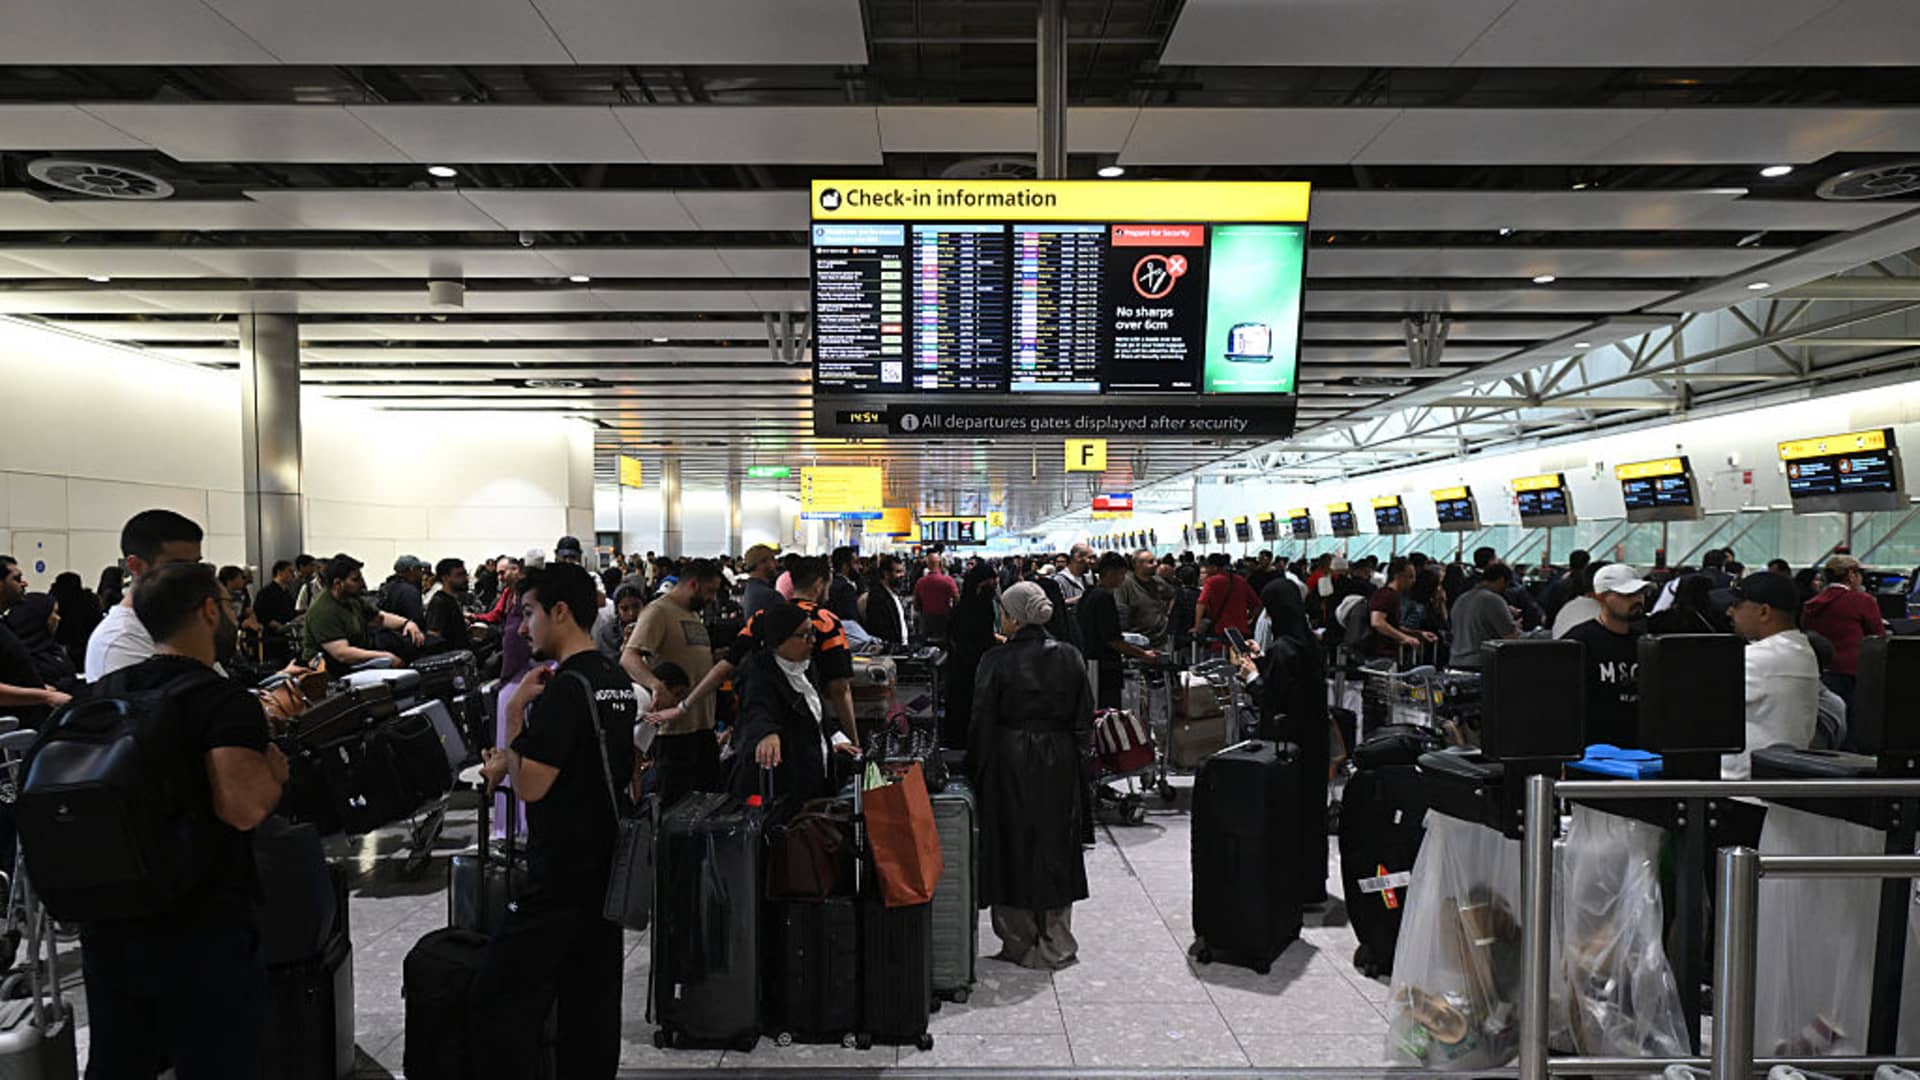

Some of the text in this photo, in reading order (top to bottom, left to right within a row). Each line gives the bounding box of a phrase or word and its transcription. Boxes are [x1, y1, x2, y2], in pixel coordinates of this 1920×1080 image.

[846, 188, 1057, 207] Check-in information
[1116, 306, 1174, 320] No sharps
[1114, 320, 1168, 330] over 6cm
[922, 414, 1249, 433] All departures gates displayed after security
[1081, 444, 1094, 466] F
